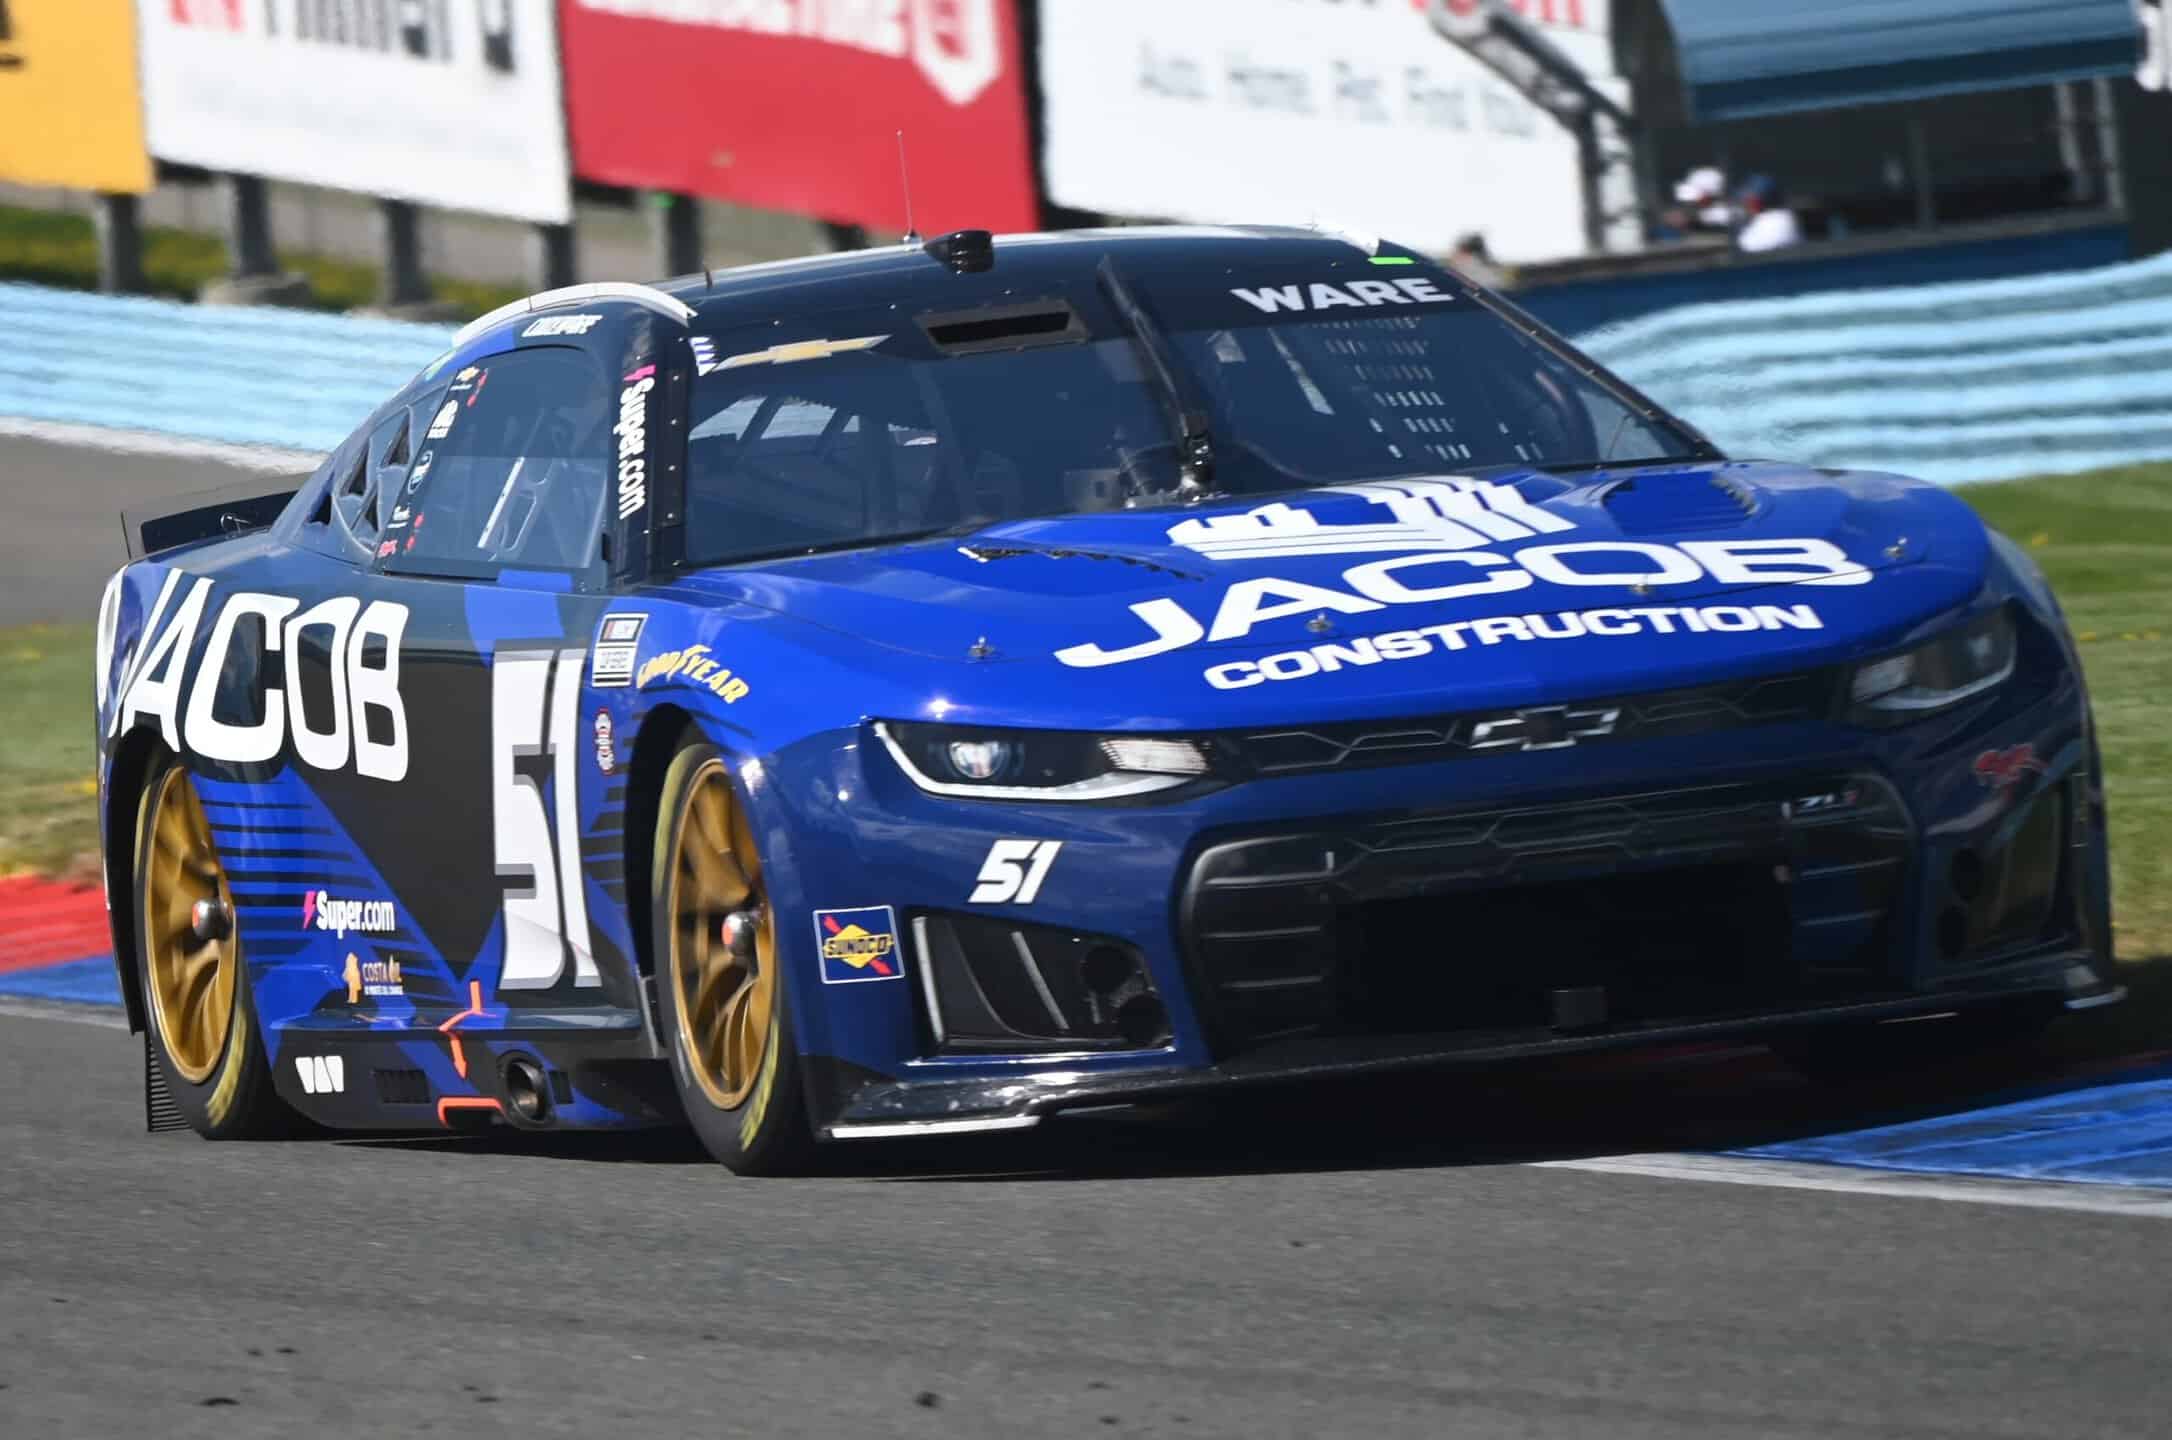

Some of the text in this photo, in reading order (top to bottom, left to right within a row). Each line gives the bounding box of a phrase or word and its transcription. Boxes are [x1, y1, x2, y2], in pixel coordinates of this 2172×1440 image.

[1230, 277, 1455, 313] WARE
[612, 376, 656, 521] Super.com
[1053, 538, 1873, 668] JACOB
[108, 566, 409, 783] JACOB
[1203, 604, 1824, 690] CONSTRUCTION
[492, 648, 602, 990] 51
[316, 890, 395, 940] Super.com
[968, 840, 1064, 904] 51
[826, 936, 889, 956] SUNOCO
